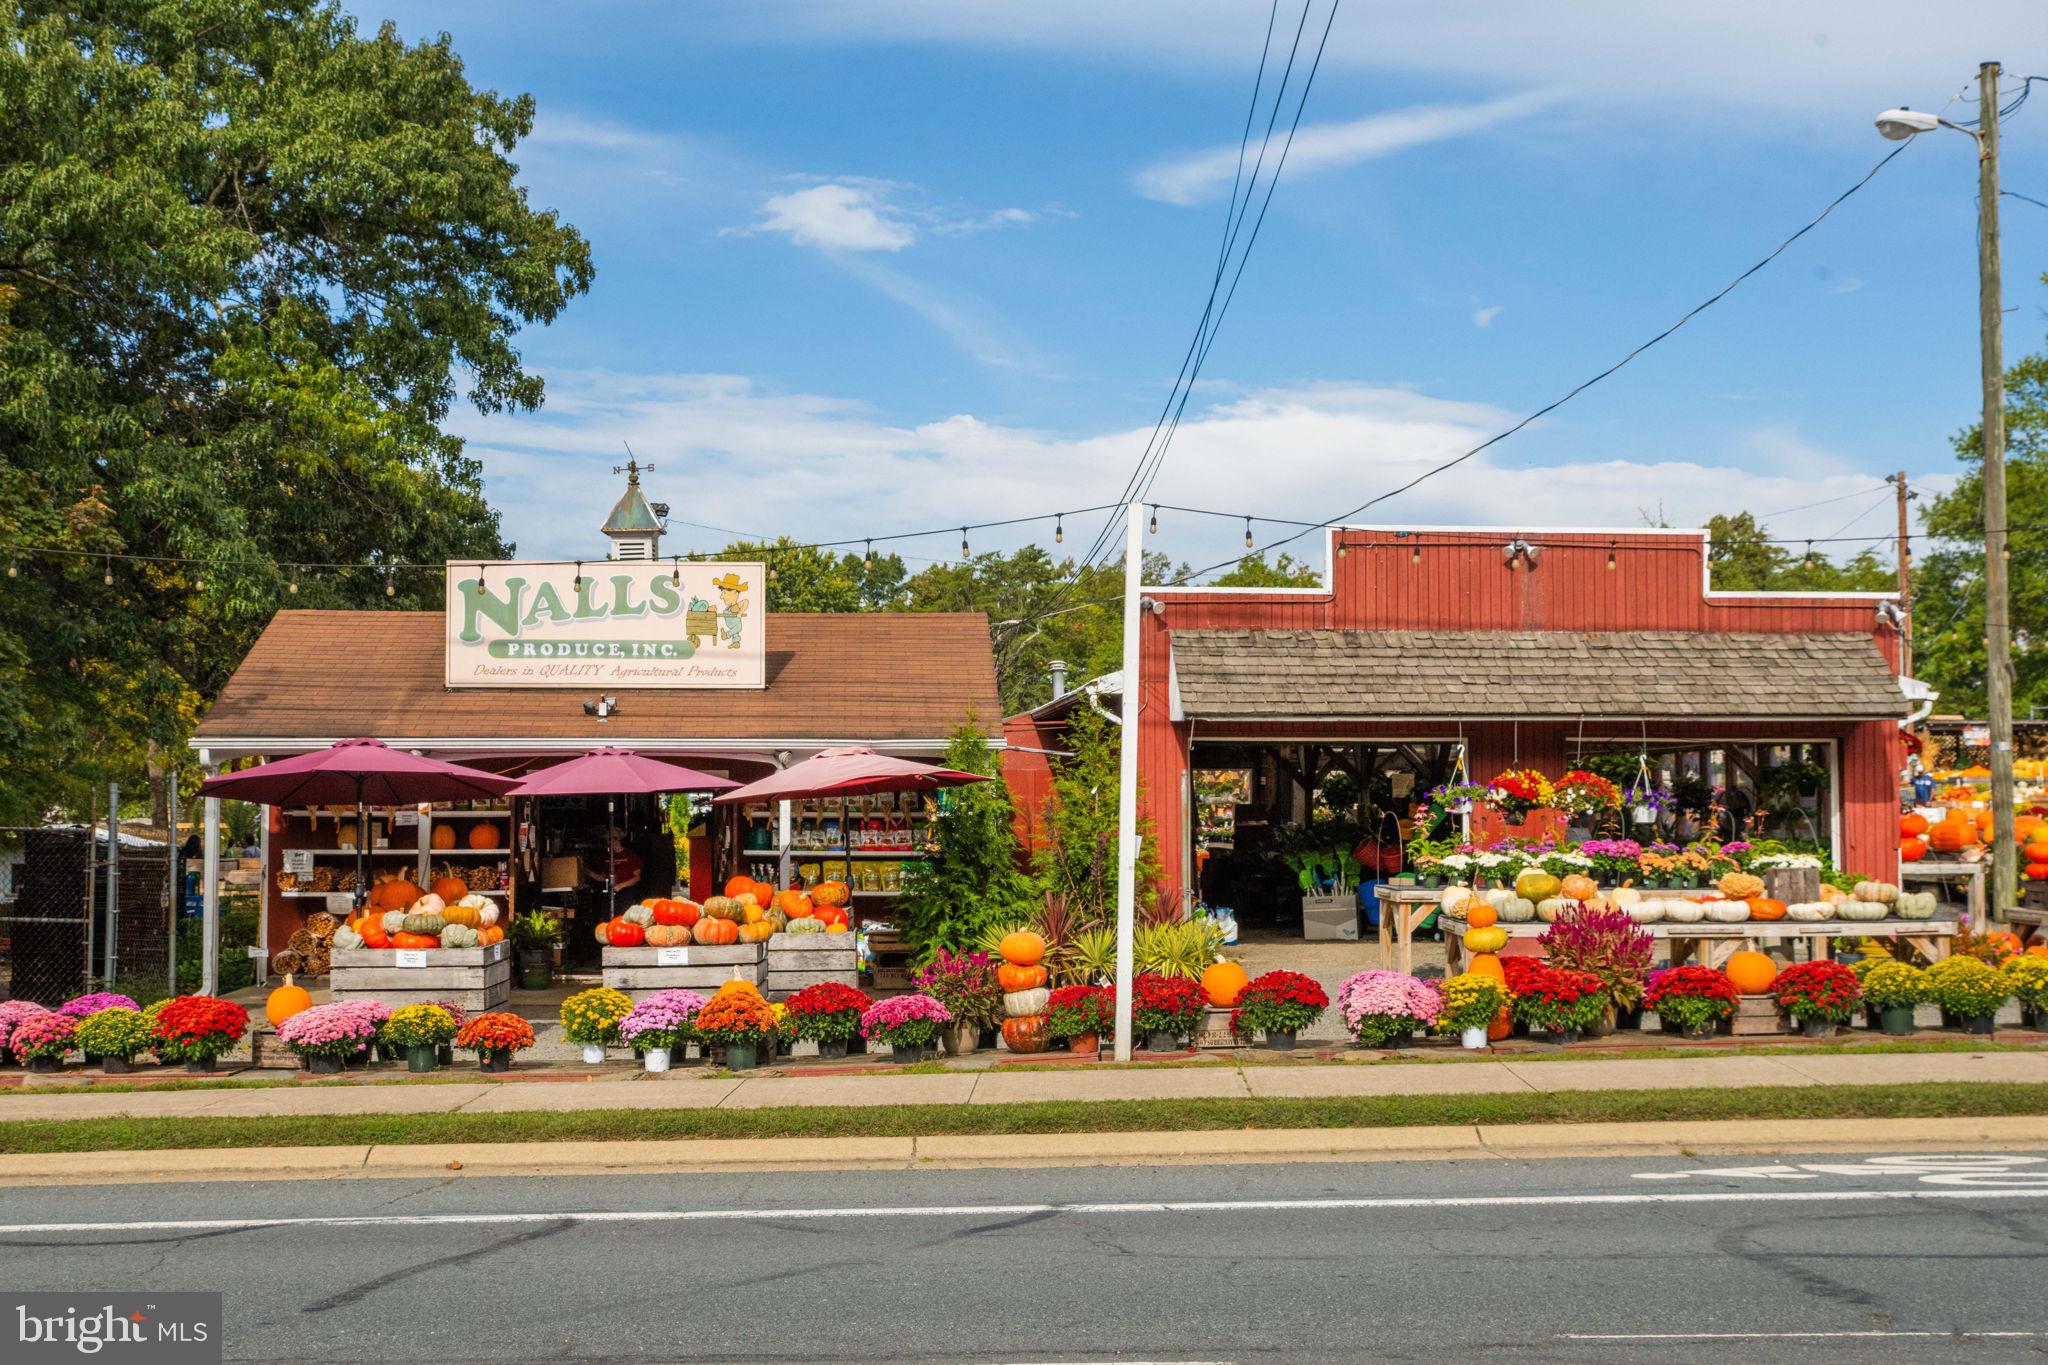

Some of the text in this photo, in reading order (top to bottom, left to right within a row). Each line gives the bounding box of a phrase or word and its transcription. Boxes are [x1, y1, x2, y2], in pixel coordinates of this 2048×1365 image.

[457, 574, 683, 642] NALLS
[507, 642, 678, 658] PRODUCE, INC.
[473, 664, 738, 679] Dealers in QUALITY Agricultural Products
